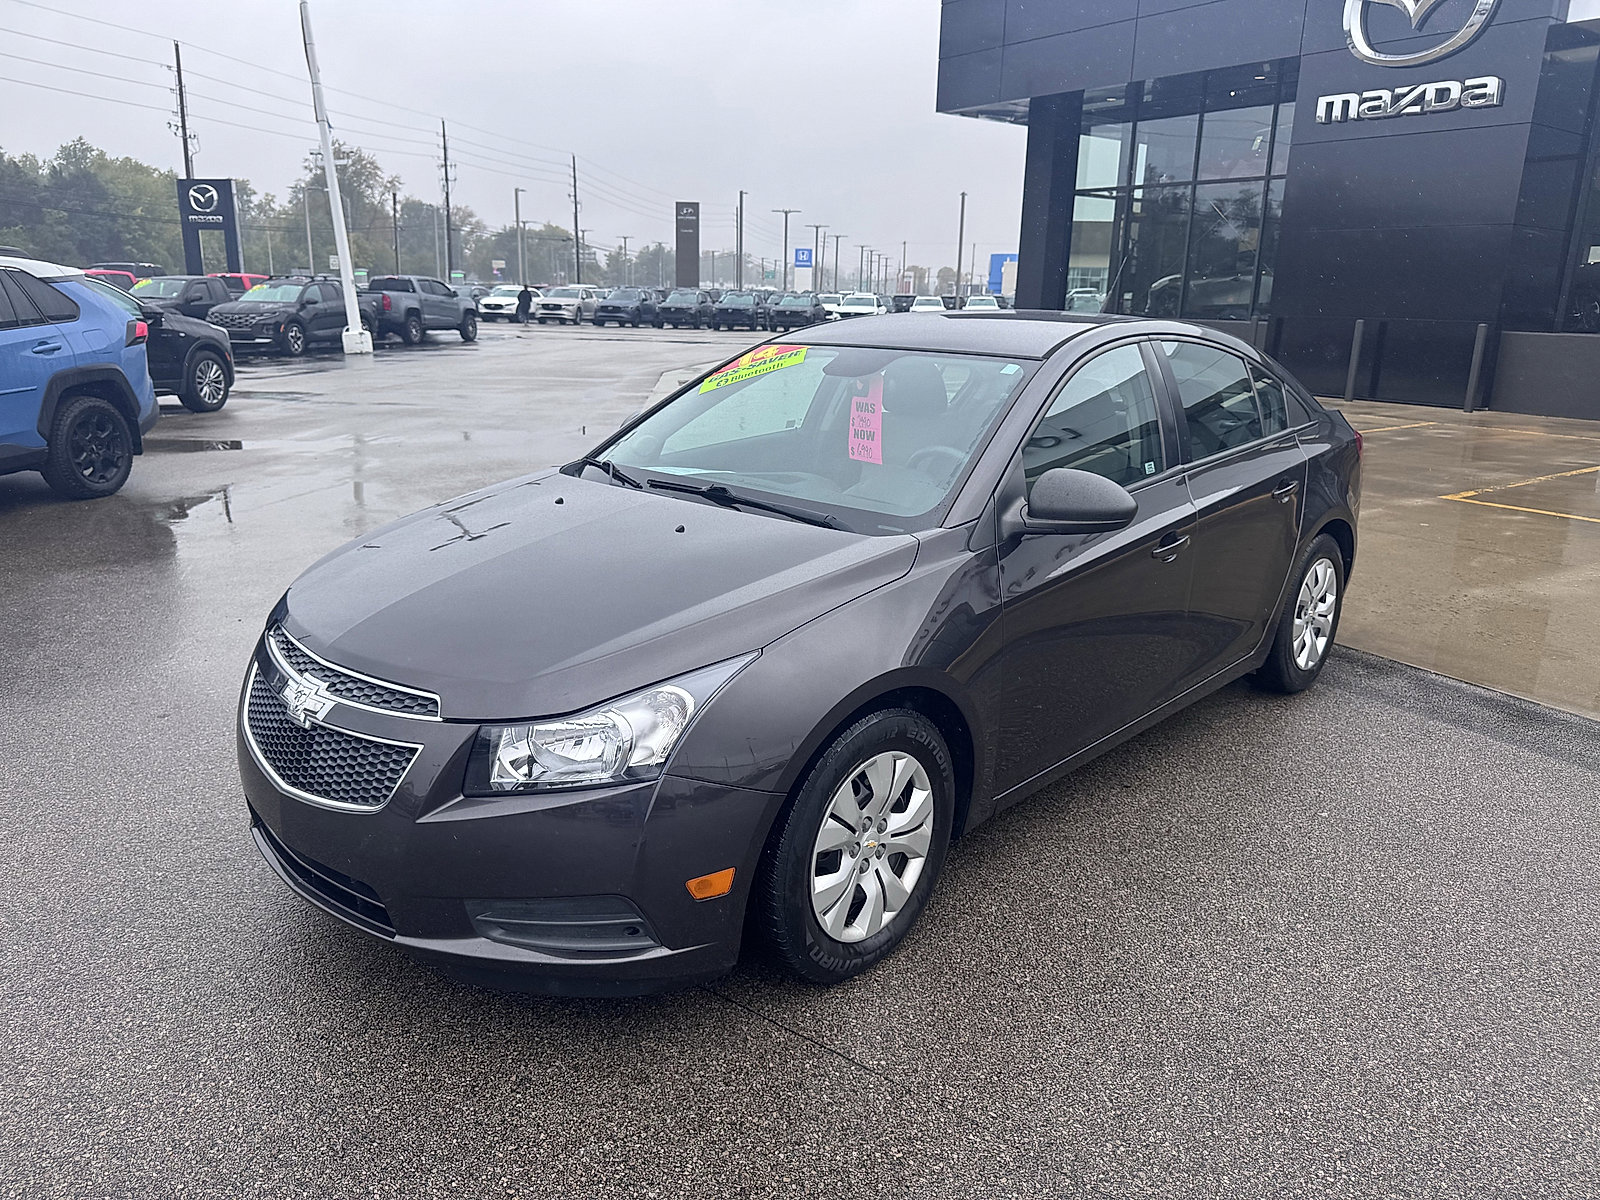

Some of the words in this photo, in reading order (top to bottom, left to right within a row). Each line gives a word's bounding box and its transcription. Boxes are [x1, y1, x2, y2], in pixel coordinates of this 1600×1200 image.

[1316, 75, 1505, 124] mazda
[707, 350, 803, 382] GAS-SAVER
[738, 346, 780, 366] 14
[730, 362, 784, 383] Bluetooth
[855, 401, 876, 414] WAS
[853, 428, 876, 441] NOW
[906, 727, 949, 777] EDITION
